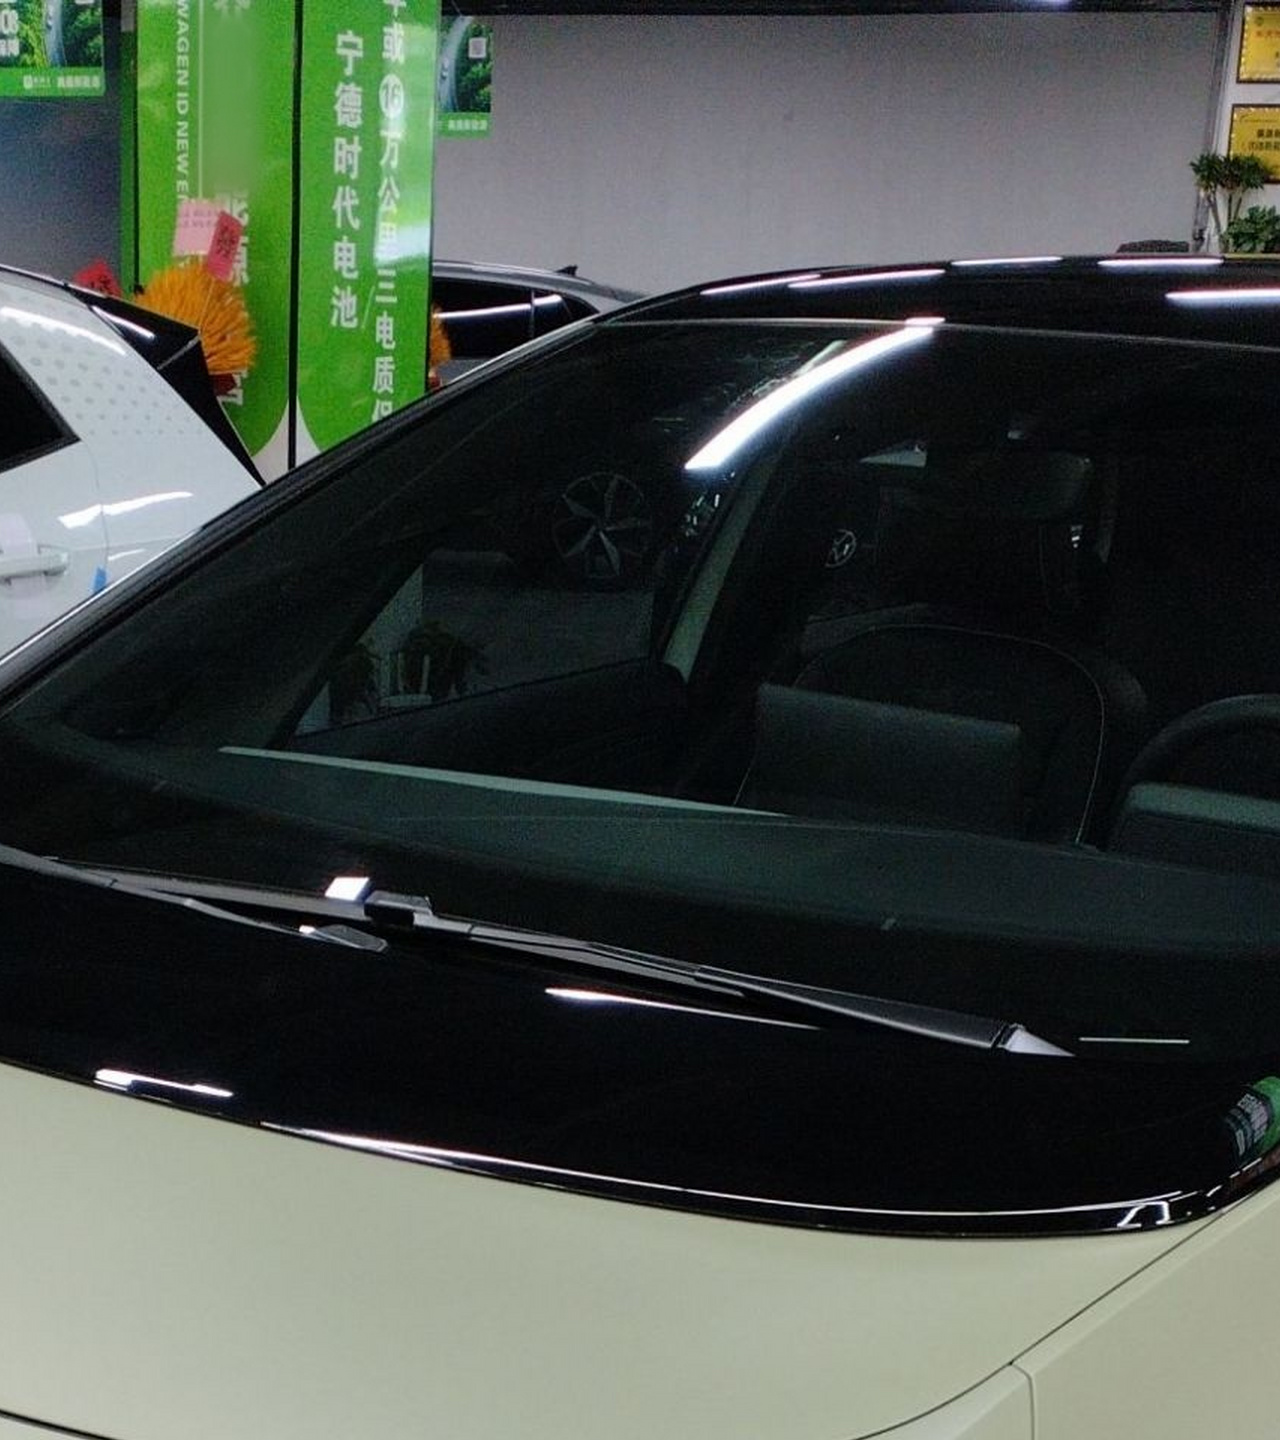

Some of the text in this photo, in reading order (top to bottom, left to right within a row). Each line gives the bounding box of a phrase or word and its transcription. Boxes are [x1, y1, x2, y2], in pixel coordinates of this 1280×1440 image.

[176, 121, 190, 178] NEW
[330, 30, 365, 328] 宁德时代电池
